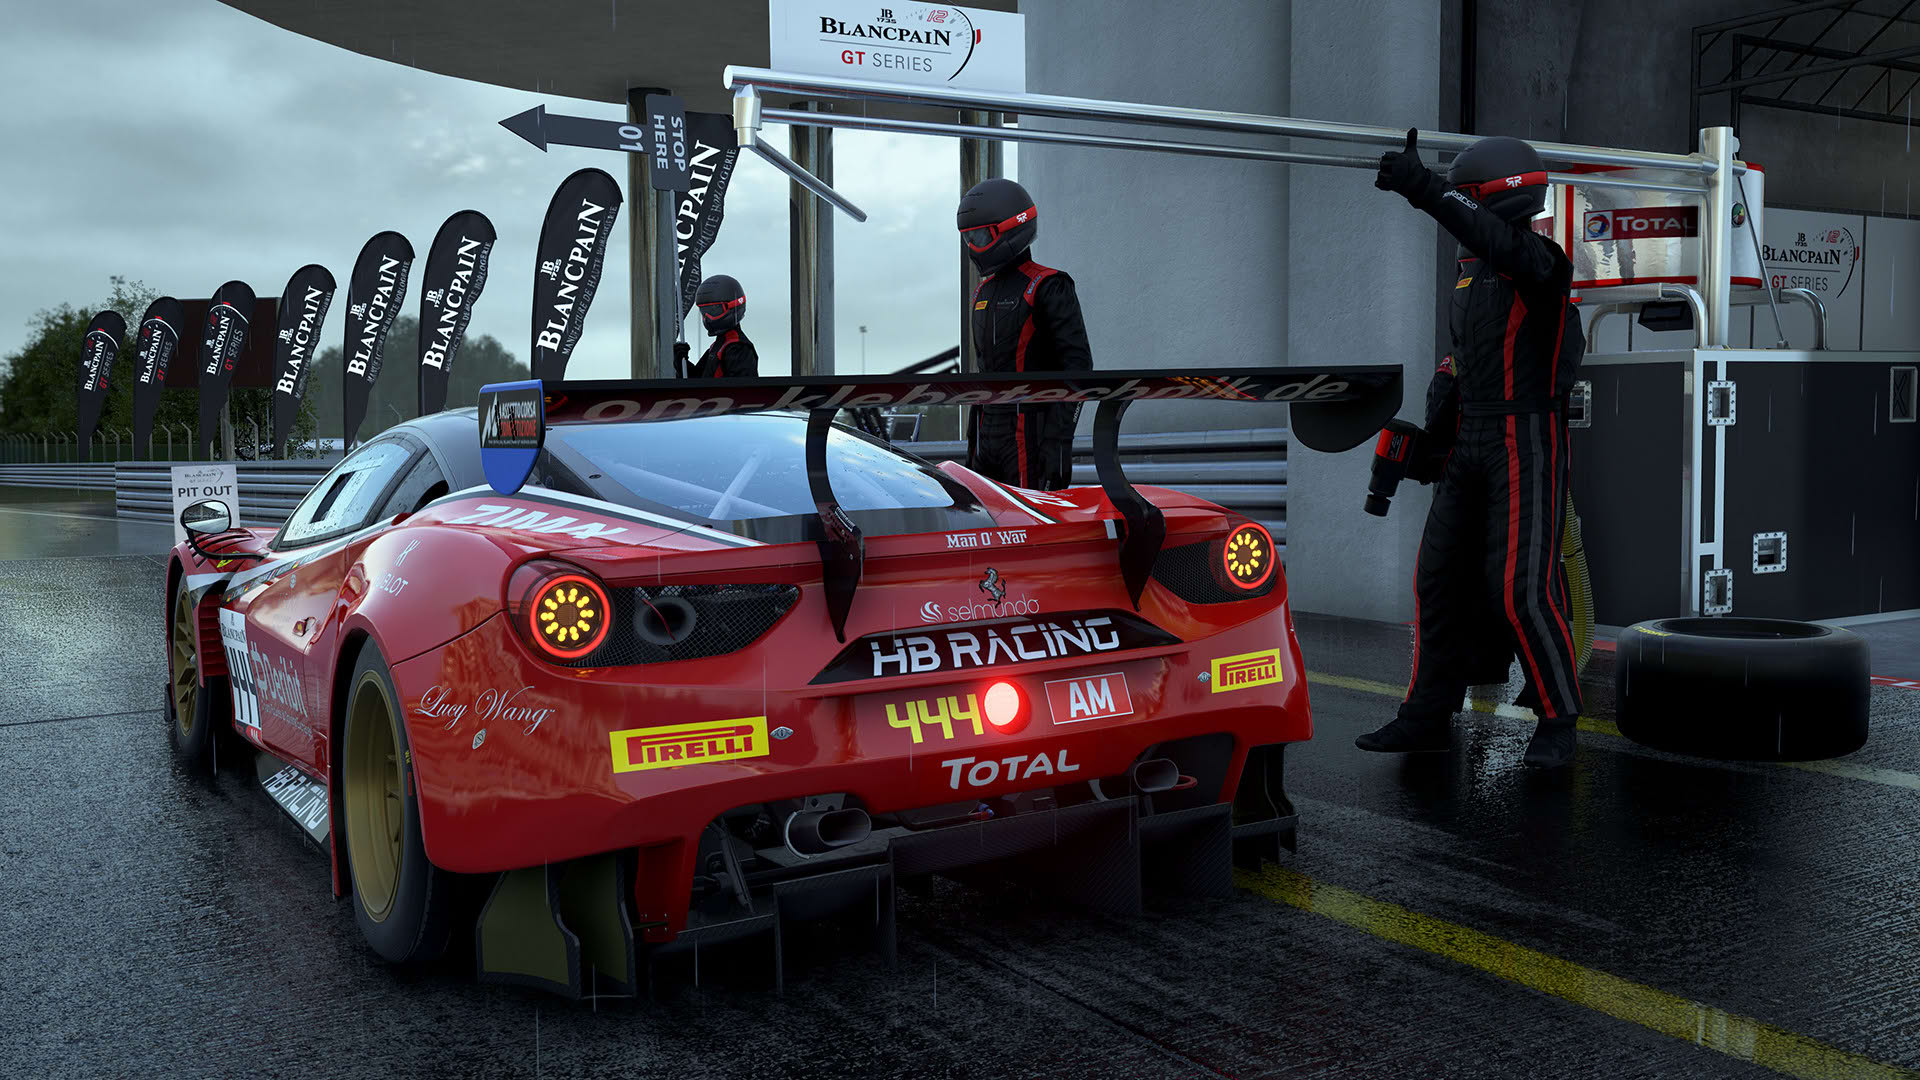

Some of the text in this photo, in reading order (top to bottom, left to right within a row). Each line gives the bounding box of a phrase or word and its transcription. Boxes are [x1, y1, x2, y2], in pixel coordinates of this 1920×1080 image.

[820, 16, 952, 46] BLANCPAIN
[926, 10, 948, 23] 12
[841, 50, 932, 72] GT SERIES
[618, 125, 644, 152] 01
[653, 114, 668, 170] HERE
[670, 116, 686, 172] STOP
[1616, 216, 1697, 232] TOTAL
[1762, 244, 1841, 265] BLANCPAIN
[536, 198, 605, 352] BLANCPAIN
[583, 286, 594, 302] DE
[1772, 275, 1828, 292] GT SERIES
[347, 254, 400, 377] BLANCPAIN
[422, 236, 482, 370] BLANCPAIN
[140, 328, 163, 384] BLANCPAIN
[206, 316, 231, 375] BLANCPAIN
[228, 328, 244, 358] SERIES
[276, 286, 323, 394] BLANCPAIN
[84, 340, 104, 391] BLANCPAIN
[178, 486, 232, 498] PIT OUT
[946, 530, 1028, 548] Man O' War
[948, 594, 1040, 622] selmundo
[870, 616, 1120, 676] HB RACING
[1220, 654, 1276, 687] PIRELLI
[414, 686, 468, 730] Lucy
[1069, 678, 1116, 718] AM
[885, 694, 984, 744] 444
[626, 724, 754, 766] PIRELLI
[942, 750, 1080, 790] TOTAL
